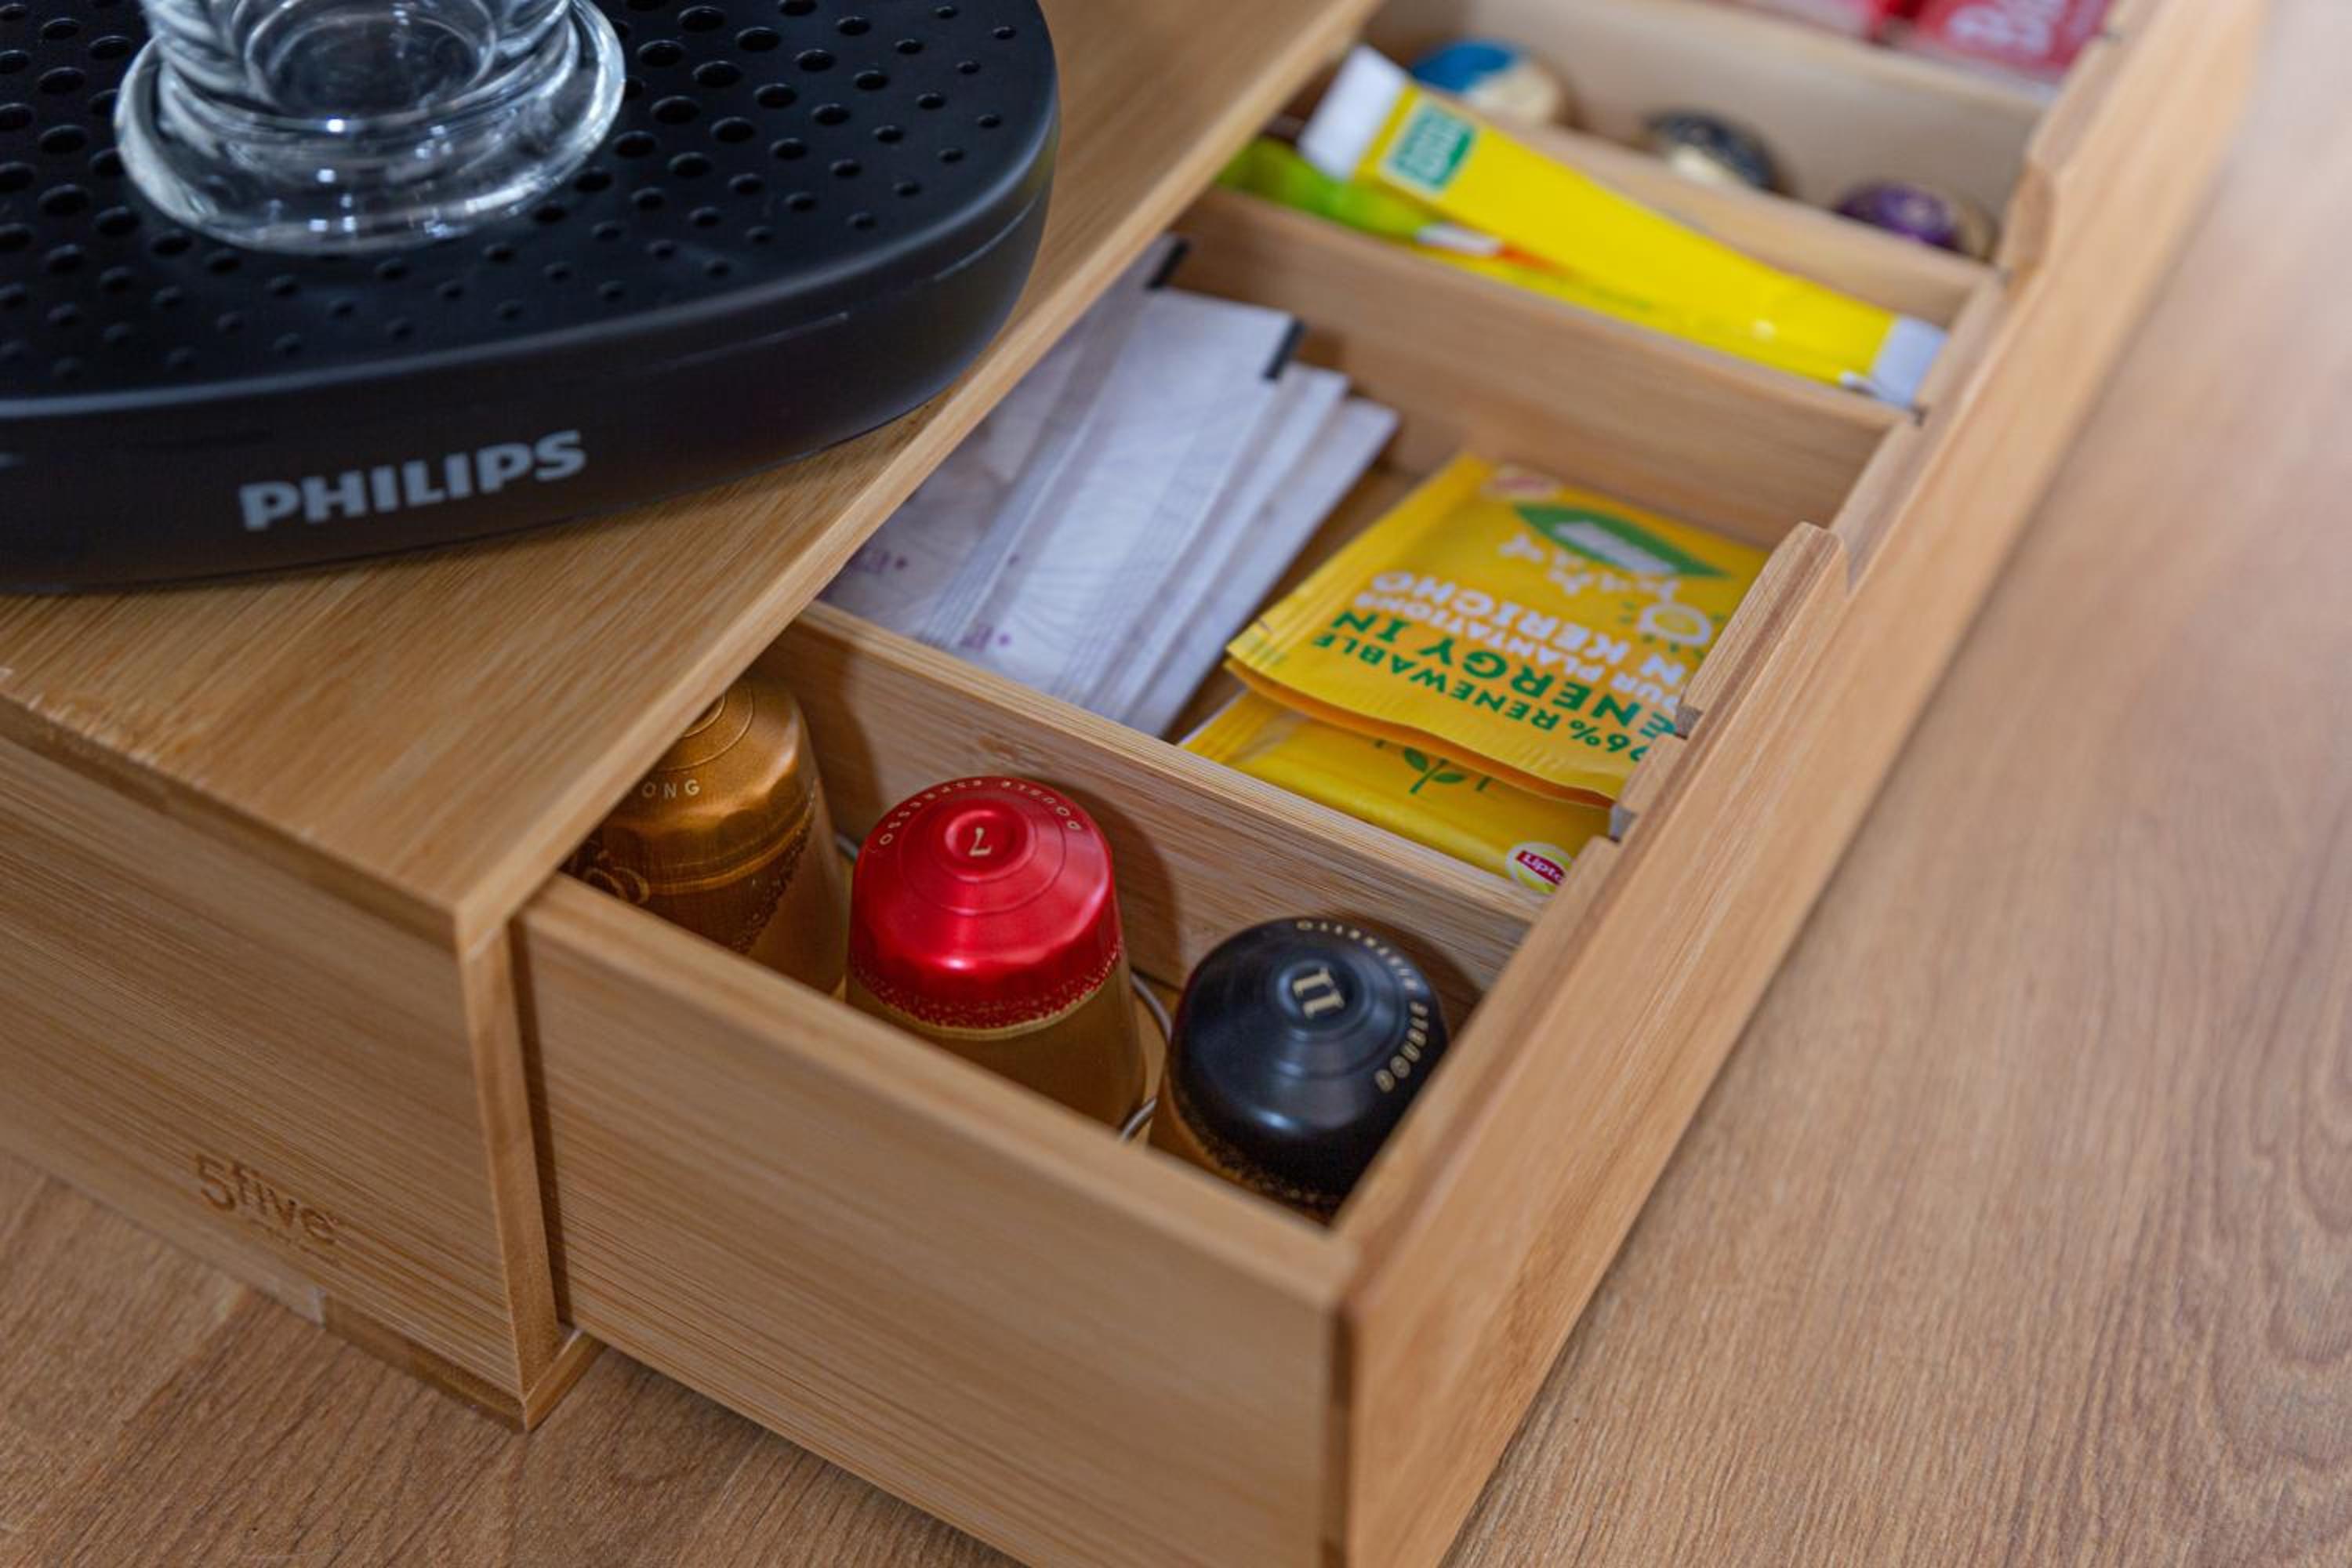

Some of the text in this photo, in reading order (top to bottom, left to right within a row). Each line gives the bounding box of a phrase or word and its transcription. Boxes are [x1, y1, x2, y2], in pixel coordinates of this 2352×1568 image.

[238, 430, 586, 531] PHILIPS
[1330, 611, 1676, 739] ENERGY IN
[1354, 592, 1604, 681] PLANTATIONS
[1373, 572, 1685, 687] N KERICHO
[1312, 633, 1560, 730] RENEWABLE
[642, 779, 700, 798] ONG
[968, 827, 992, 856] 7
[1374, 1000, 1428, 1093] DOUBLE
[196, 1152, 337, 1246] 5five
